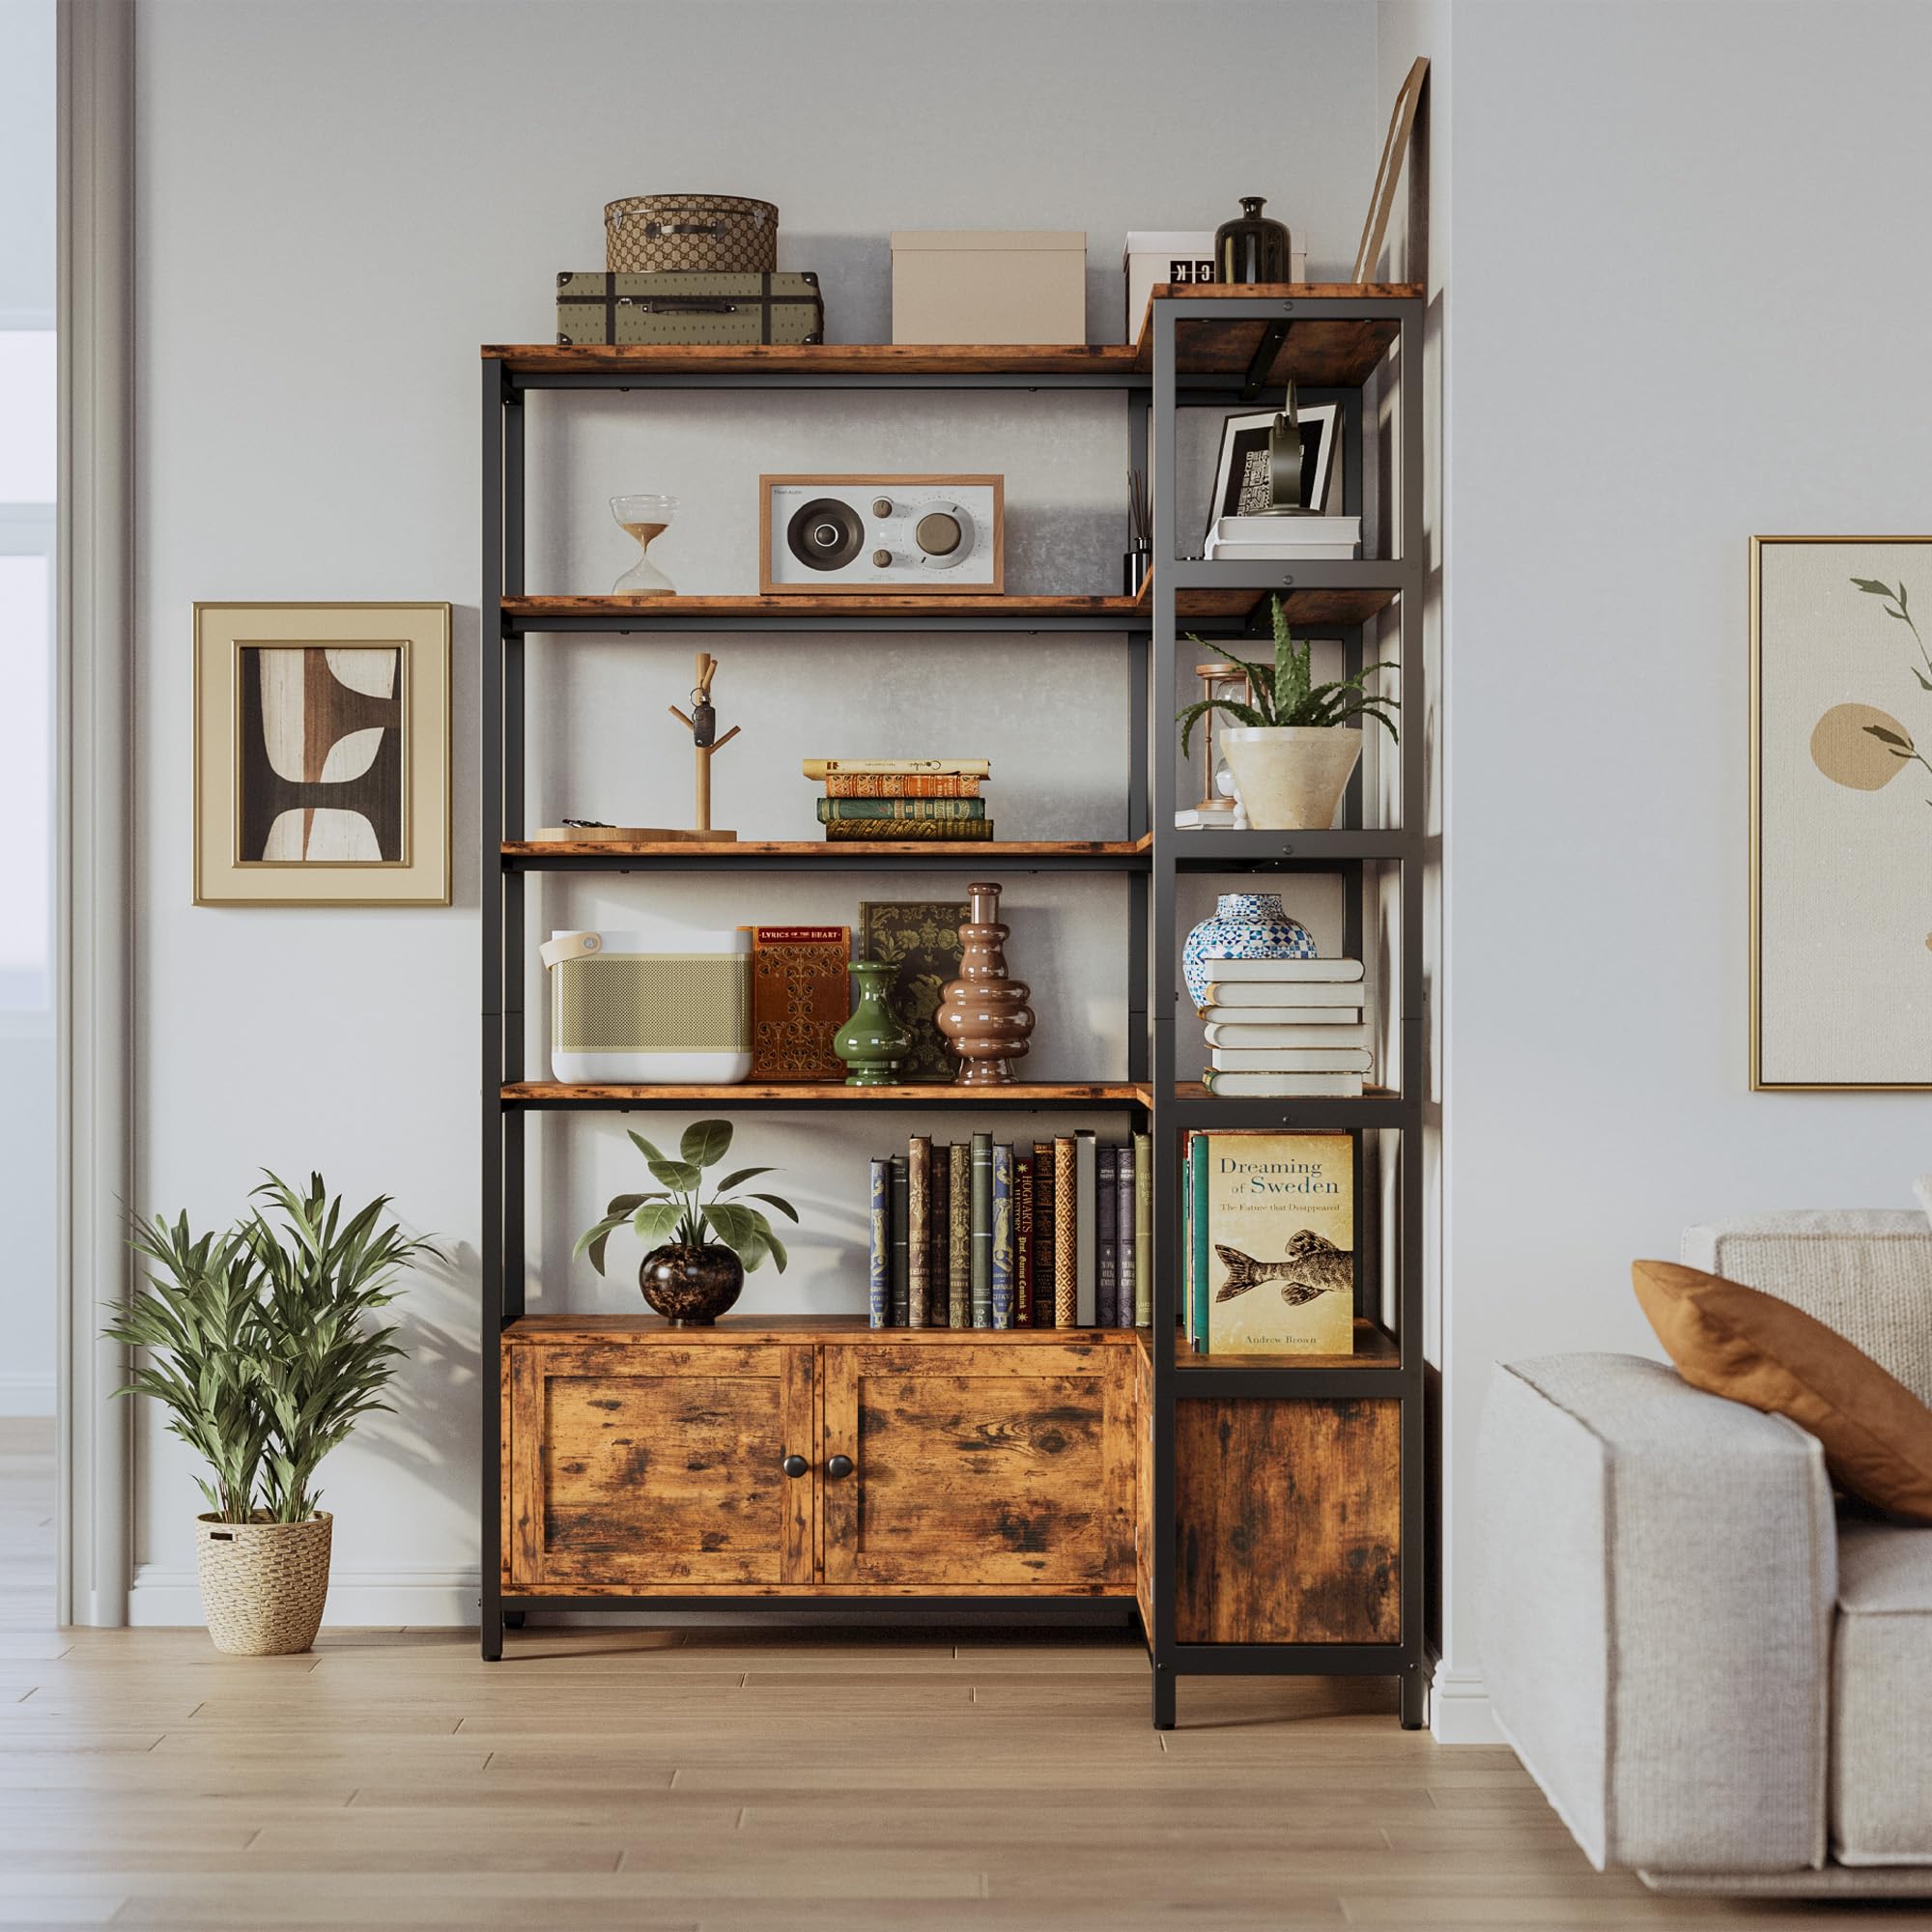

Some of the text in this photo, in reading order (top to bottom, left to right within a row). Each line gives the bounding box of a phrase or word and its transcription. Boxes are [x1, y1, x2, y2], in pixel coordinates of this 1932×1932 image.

[1220, 1157, 1322, 1178] Dreaming
[1231, 1176, 1340, 1194] of Sweden
[1022, 1176, 1033, 1233] HOGWARTS
[1289, 1204, 1340, 1212] Disappeared
[1246, 1335, 1283, 1344] Andrew
